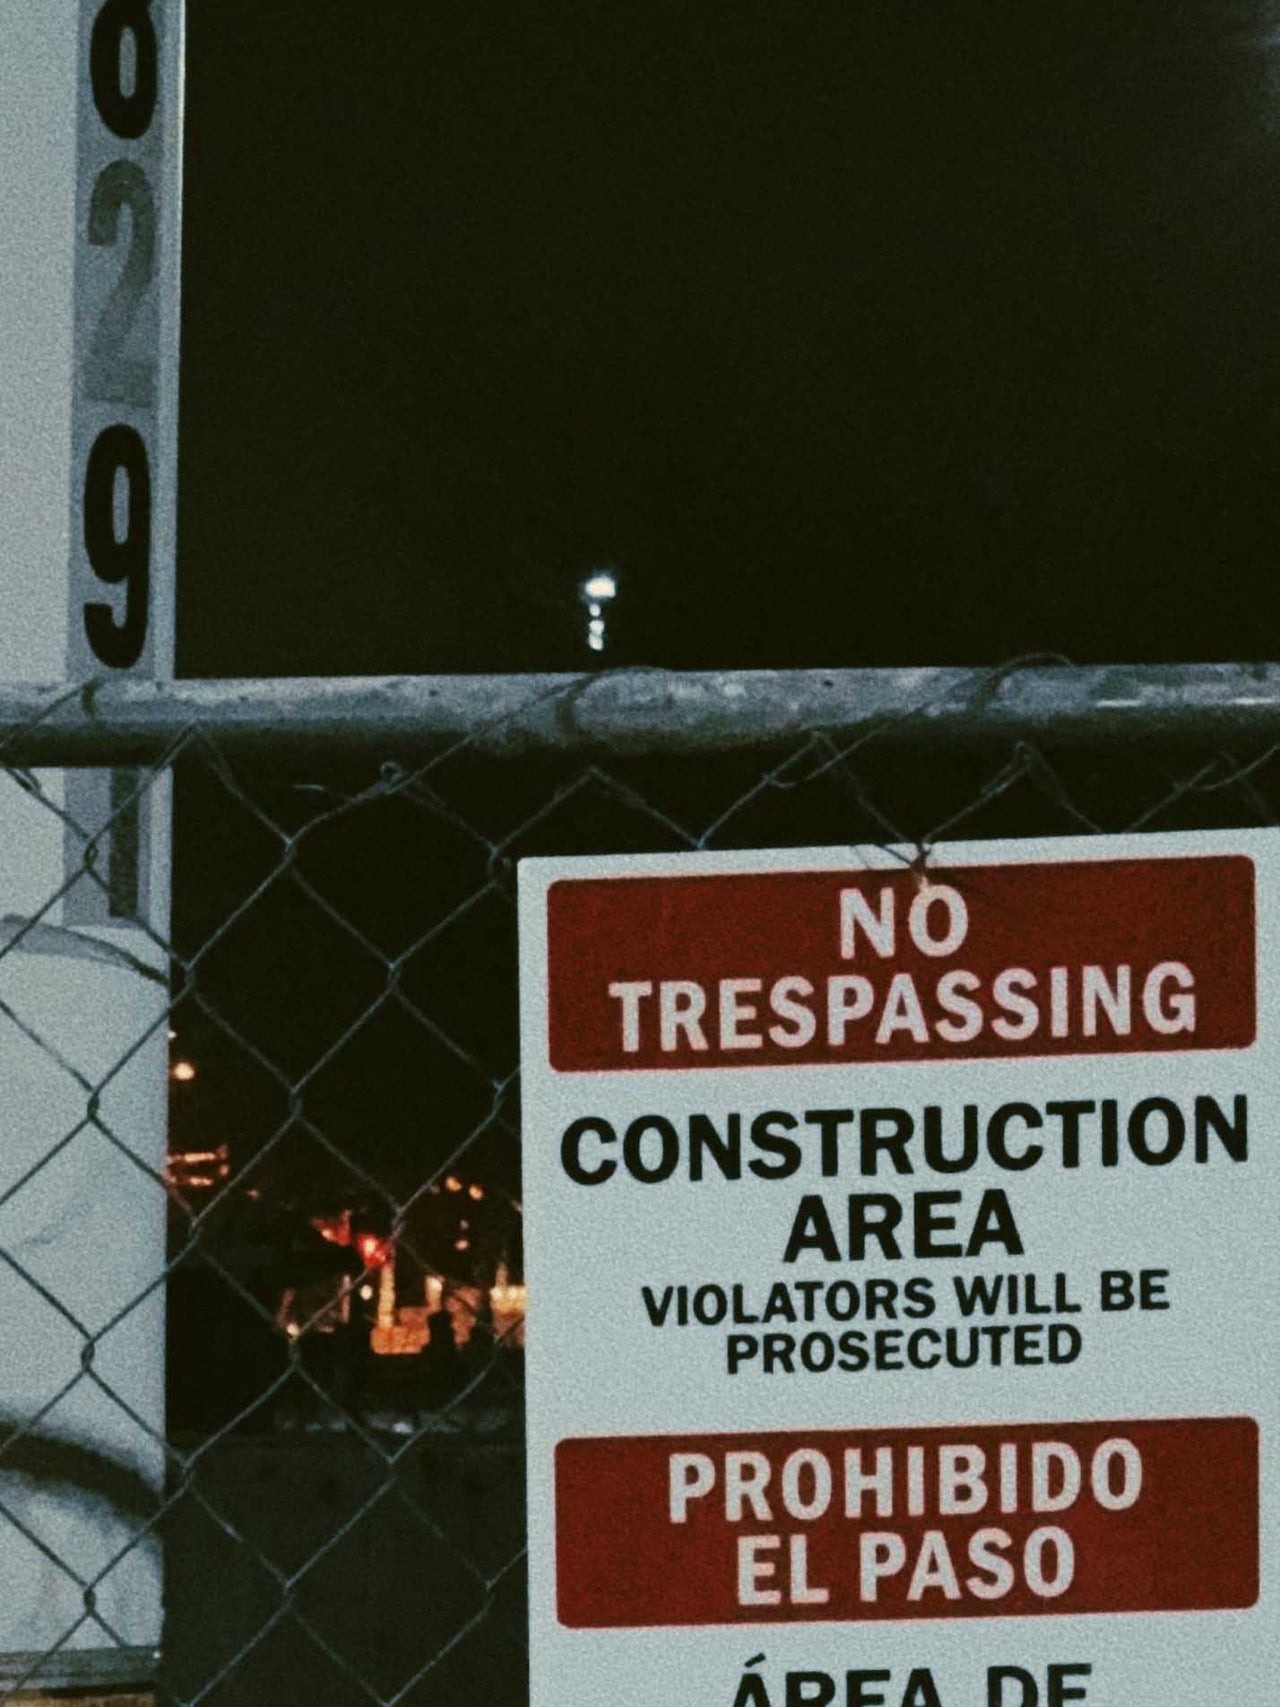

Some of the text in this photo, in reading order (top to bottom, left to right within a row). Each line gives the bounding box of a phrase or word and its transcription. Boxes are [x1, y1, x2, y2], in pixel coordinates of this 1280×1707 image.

[840, 884, 968, 959] NO
[609, 962, 1196, 1053] TRESPASSING
[560, 1094, 1248, 1186] CONSTRUCTION
[783, 1188, 1024, 1263] AREA
[641, 1269, 1170, 1327] VIOLATORS WILL BE
[726, 1324, 1082, 1375] PROSECUTED
[669, 1438, 1142, 1523] PROHIBIDO
[738, 1526, 1074, 1605] EL PASO
